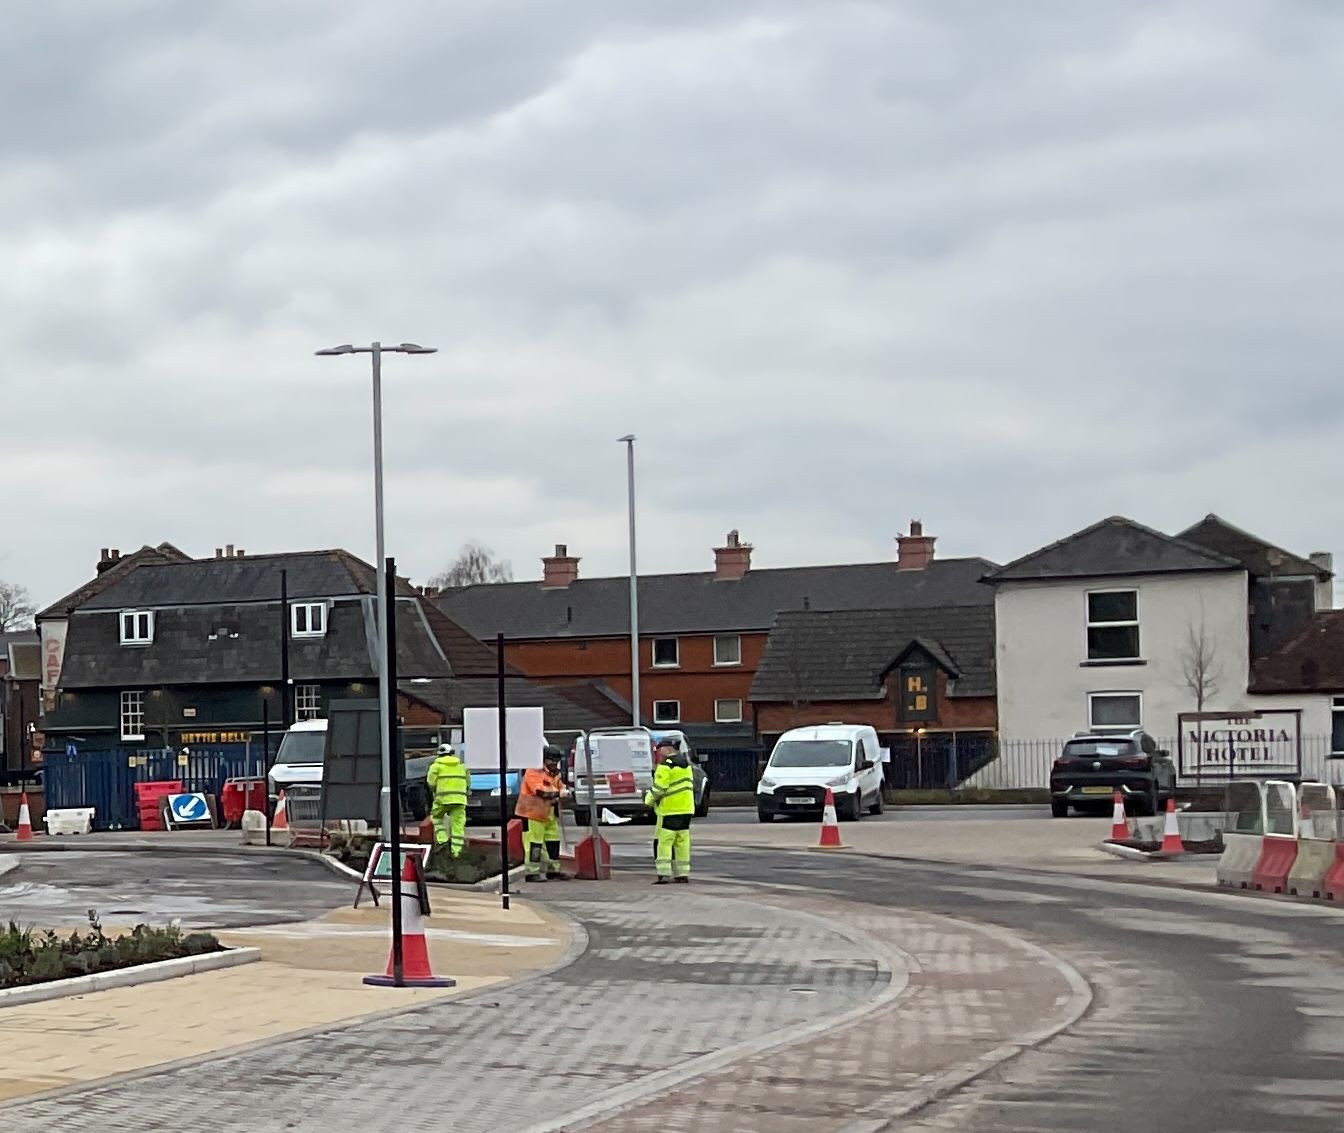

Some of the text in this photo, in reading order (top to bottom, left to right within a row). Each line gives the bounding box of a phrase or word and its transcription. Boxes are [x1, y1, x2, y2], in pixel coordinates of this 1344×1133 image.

[181, 732, 248, 743] HETTIE BELL
[1189, 728, 1291, 743] VICTORIA
[1206, 747, 1273, 761] HOTEL
